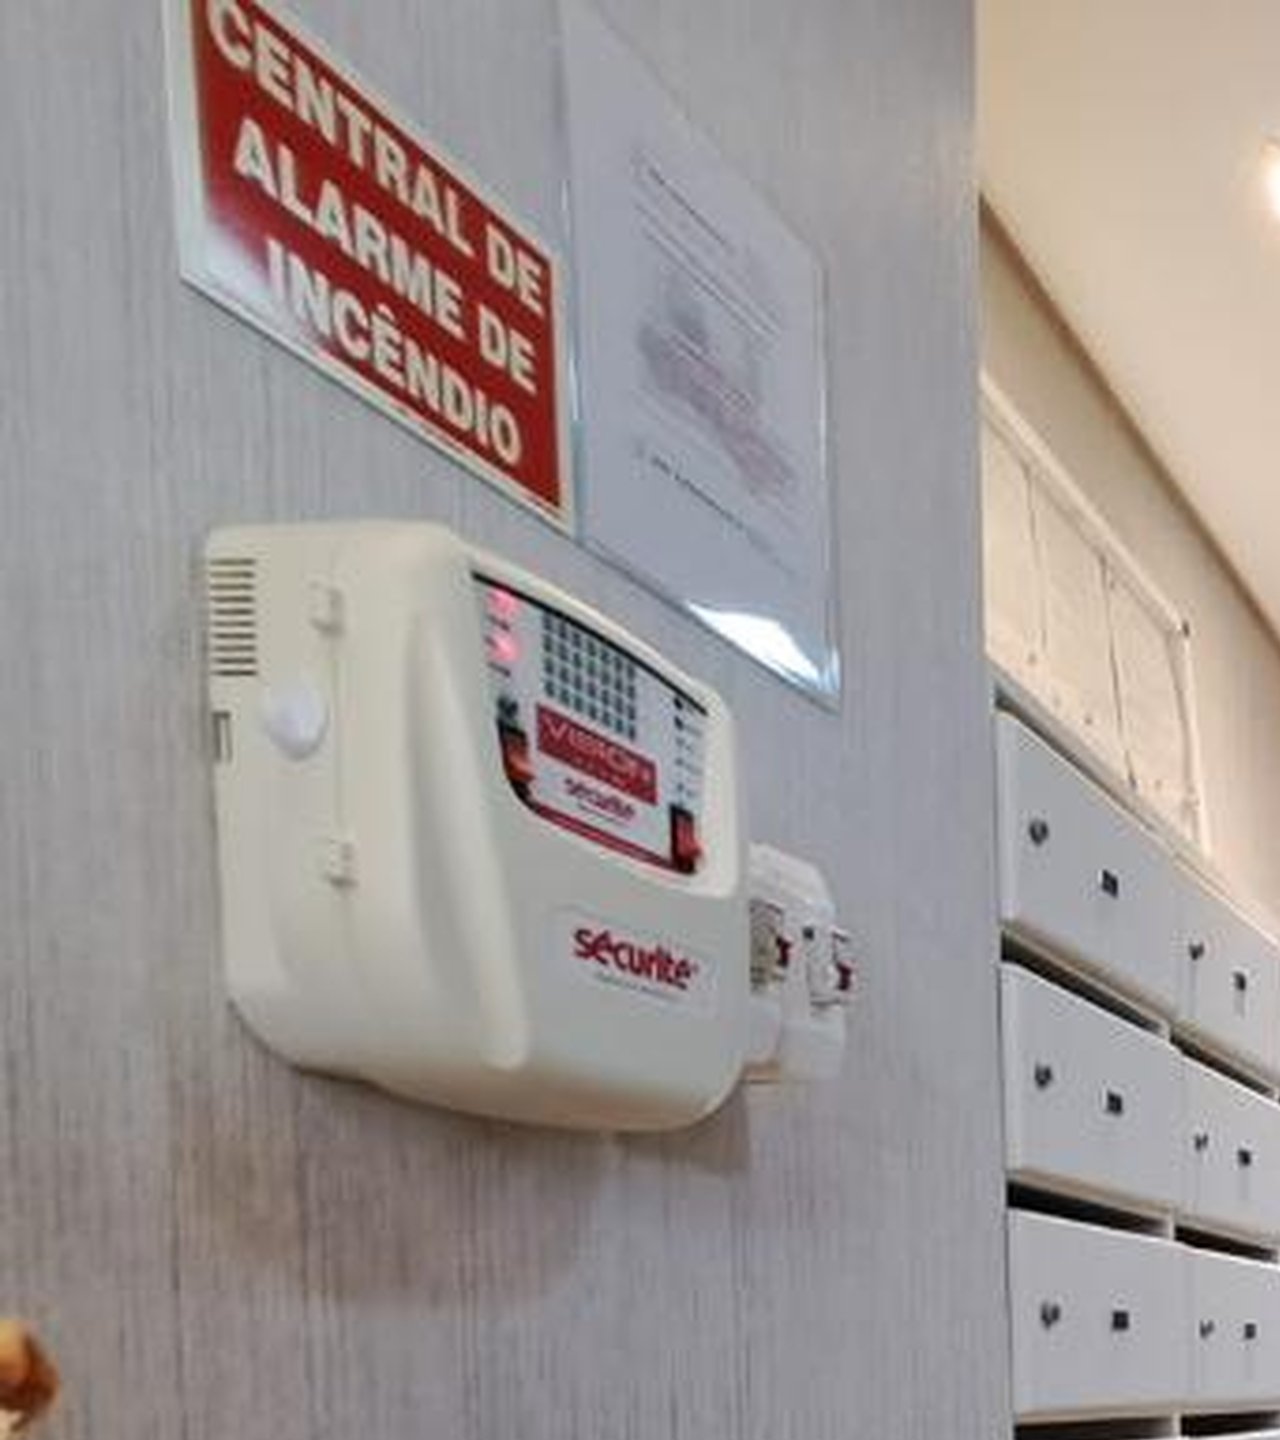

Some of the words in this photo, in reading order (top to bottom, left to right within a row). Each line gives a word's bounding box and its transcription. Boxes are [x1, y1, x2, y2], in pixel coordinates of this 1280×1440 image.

[207, 0, 477, 257] CENTRAL
[486, 223, 545, 318] DE
[233, 117, 466, 342] ALARME
[479, 306, 537, 395] DE
[266, 238, 523, 466] INCÊNDIO
